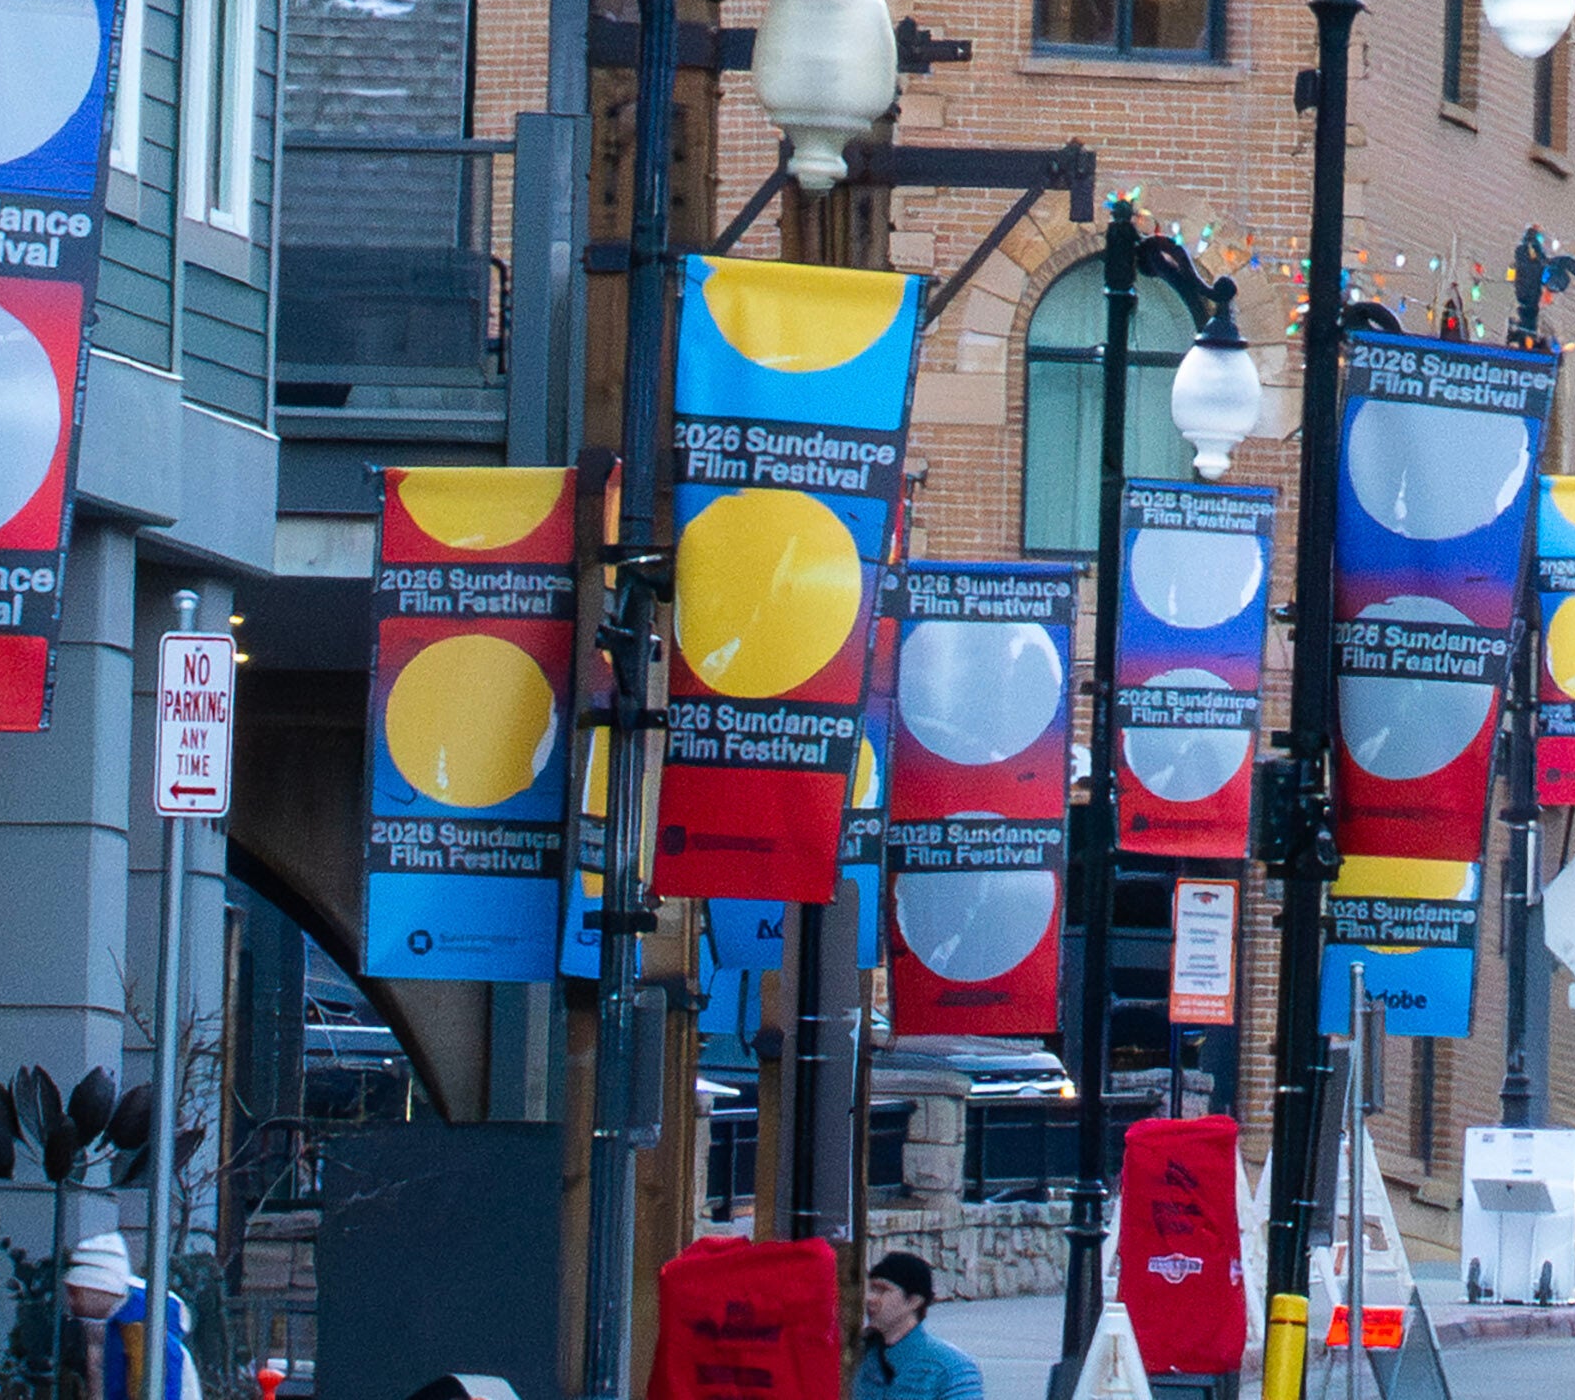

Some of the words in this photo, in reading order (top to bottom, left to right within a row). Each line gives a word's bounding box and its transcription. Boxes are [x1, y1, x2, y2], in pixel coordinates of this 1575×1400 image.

[1353, 346, 1417, 374] 2026
[1421, 353, 1549, 390] Sundance
[1370, 370, 1423, 398] Film
[1428, 377, 1526, 409] Festival
[675, 421, 741, 451] 2026
[746, 426, 896, 466] Sundance
[687, 450, 747, 480] Film
[754, 454, 870, 491] Festival
[380, 567, 444, 591] 2026
[448, 567, 573, 592] Sundance
[906, 574, 950, 595] 026
[954, 575, 1071, 598] Sundance
[398, 590, 453, 613] Film
[458, 590, 553, 614] Festival
[909, 592, 959, 615] Film
[963, 595, 1053, 617] Festival
[1384, 625, 1507, 656] Sundance
[183, 653, 210, 685] NO
[1342, 646, 1386, 670] Film
[1391, 648, 1485, 677] Festival
[164, 690, 227, 723] PARKING
[667, 703, 712, 731] 026
[716, 703, 855, 739] Sundance
[179, 727, 209, 750] ANY
[669, 730, 719, 760] Film
[725, 732, 830, 765] Festival
[177, 753, 210, 777] TIME
[371, 820, 436, 845] 2026
[439, 820, 561, 849] Sundance
[947, 823, 1062, 845] Sundance
[390, 844, 443, 868] Film
[448, 846, 543, 871] Festival
[905, 845, 952, 866] Film
[956, 844, 1044, 865] Festival
[1372, 901, 1477, 925] Sundance
[1336, 919, 1375, 939] Film
[1380, 920, 1459, 942] Festival
